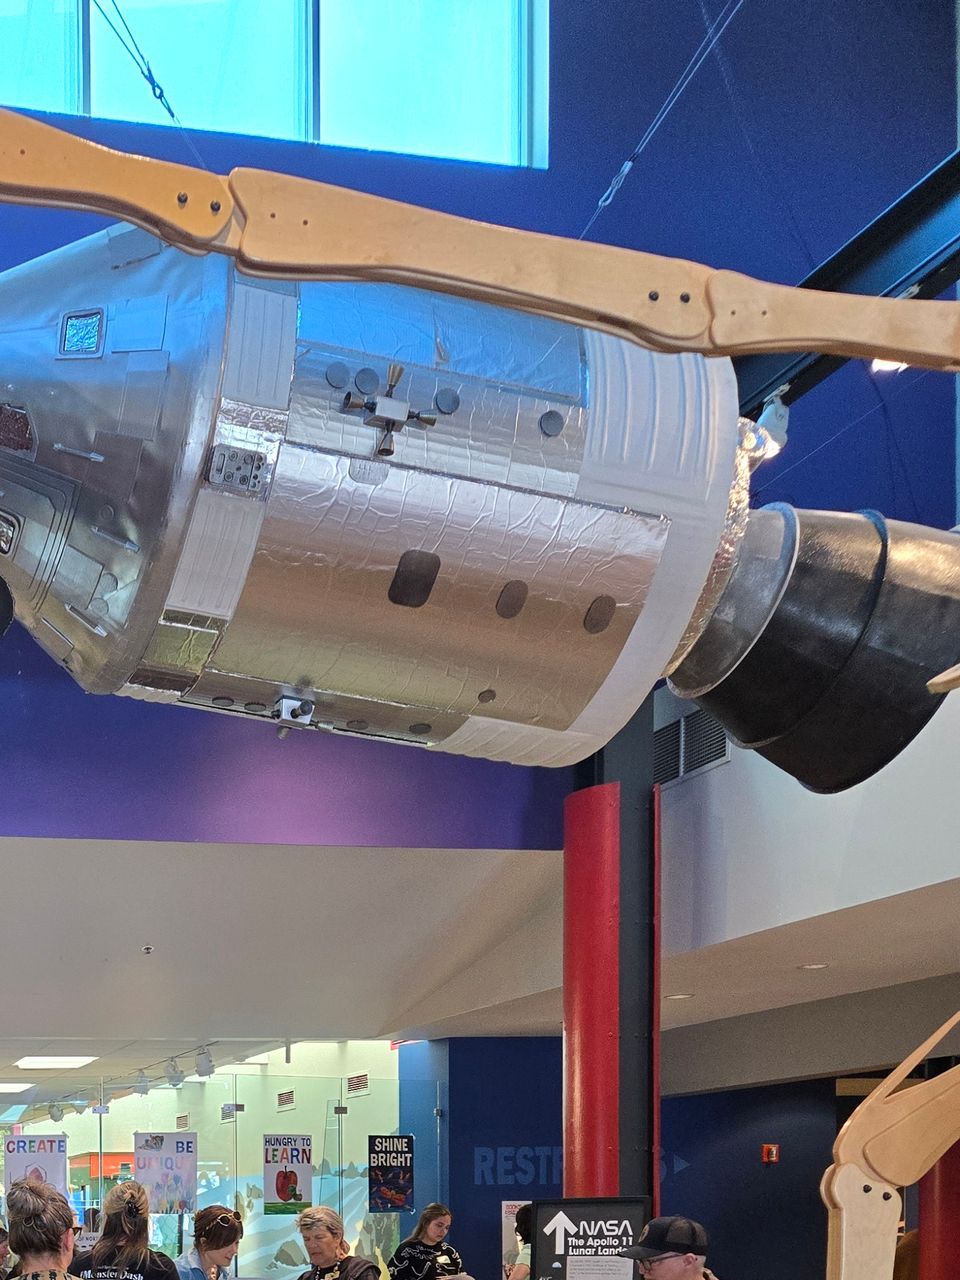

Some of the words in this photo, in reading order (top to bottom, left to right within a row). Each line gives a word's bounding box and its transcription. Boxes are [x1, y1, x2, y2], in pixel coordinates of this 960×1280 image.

[6, 1139, 66, 1154] CREATE
[175, 1140, 194, 1154] BE
[264, 1136, 297, 1147] HUNGRY
[302, 1136, 311, 1147] TO
[374, 1137, 409, 1151] SHINE
[264, 1148, 312, 1164] LEARN
[370, 1152, 412, 1167] BRIGHT
[579, 1219, 634, 1236] NASA
[567, 1237, 585, 1246] The
[586, 1236, 619, 1247] Apollo
[621, 1237, 633, 1246] 11
[568, 1246, 596, 1255] Lunar
